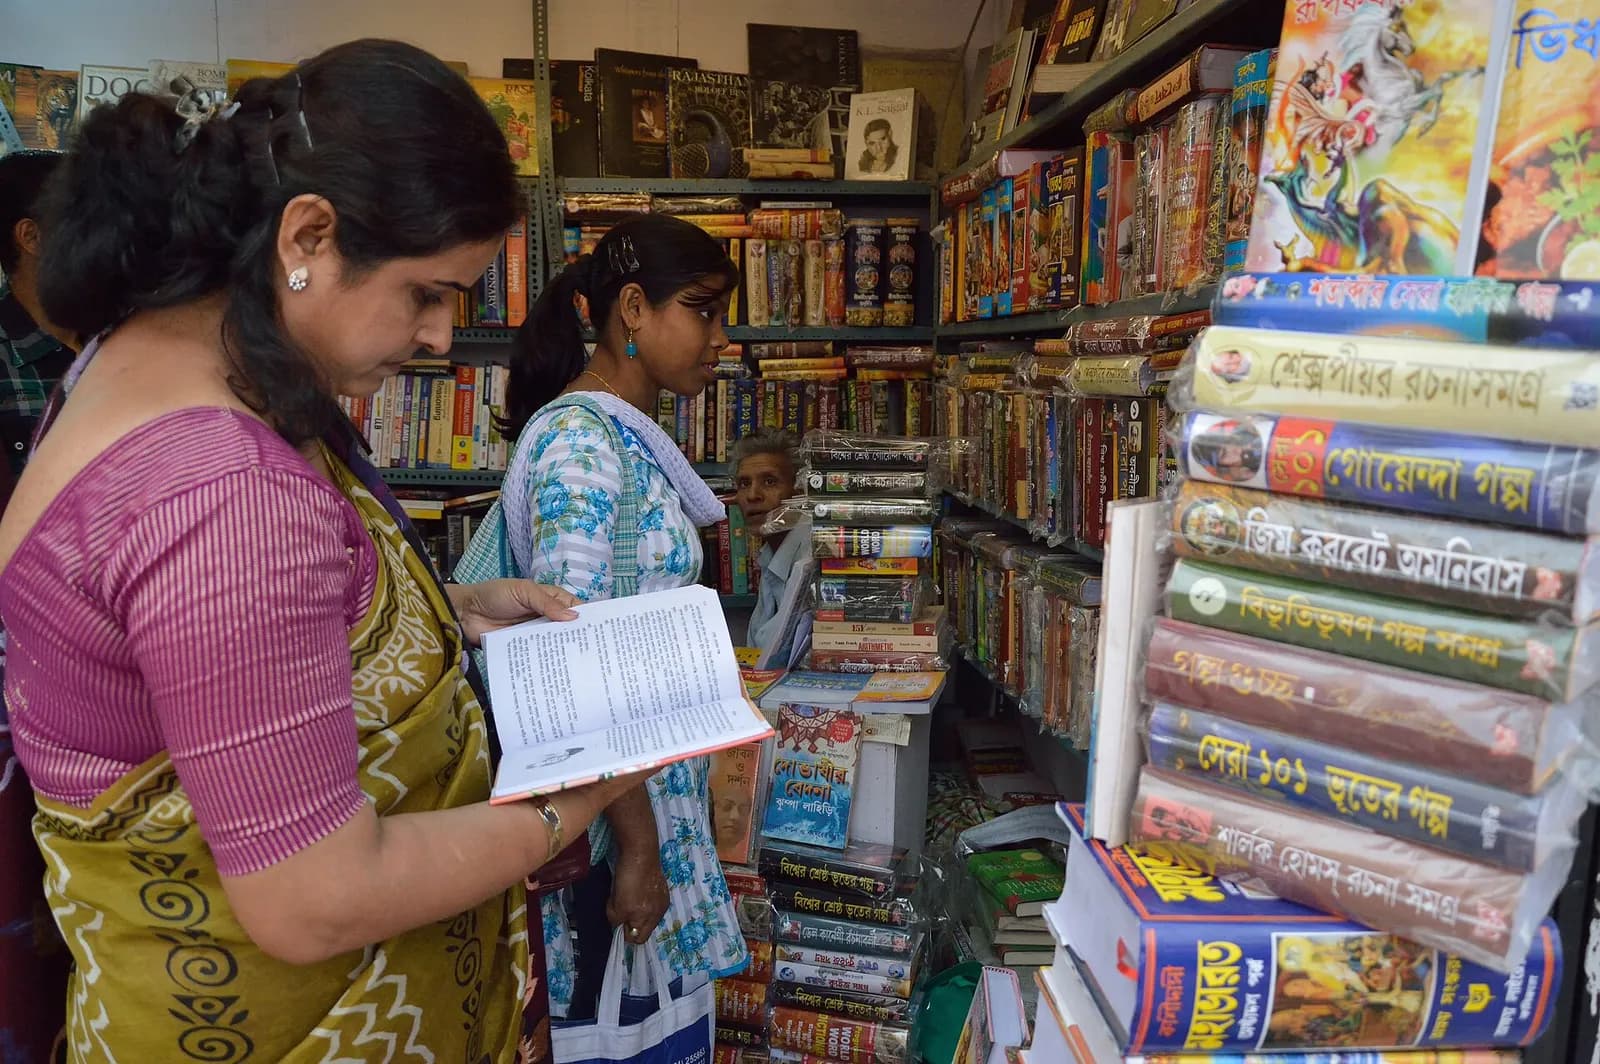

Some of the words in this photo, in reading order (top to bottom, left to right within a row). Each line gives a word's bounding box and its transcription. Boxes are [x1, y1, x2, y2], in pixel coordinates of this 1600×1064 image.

[584, 65, 593, 102] Kolkata
[487, 261, 497, 309] TIONARY
[433, 380, 444, 421] Reasoning
[1404, 363, 1545, 414] রচনাসমগ্র
[1324, 449, 1459, 500] গোয়েন্দা
[1473, 464, 1537, 513] গল্প
[861, 529, 870, 555] WORLD
[871, 531, 880, 554] WORD
[1244, 507, 1294, 556] জিম
[1300, 528, 1391, 574] করবেট
[1397, 537, 1528, 599] অমনিবাস
[1240, 587, 1373, 642] বিভূতিভূষণ
[1382, 616, 1427, 656] গল্প
[1173, 649, 1225, 688] গল্প
[774, 756, 849, 785] দোভাষীর
[1199, 732, 1252, 780] সেরা
[1260, 749, 1308, 795] ১০১
[1326, 765, 1404, 820] ভূতের
[1409, 790, 1454, 838] গল্প
[785, 778, 832, 802] বেদনা
[780, 857, 806, 877] বিশ্বের
[809, 864, 829, 882] শ্রেষ্ঠ
[859, 876, 875, 892] গল্প
[1217, 824, 1274, 868] শার্লক
[1347, 862, 1401, 907] রচনা
[794, 891, 820, 911] বিশ্বের
[823, 897, 843, 913] শ্রেষ্ঠ
[873, 908, 890, 922] গল্প
[796, 987, 821, 1007] বিশ্বের
[1183, 940, 1243, 1050] মহাভারত
[829, 1028, 839, 1056] WORD
[840, 1027, 852, 1060] WORLD
